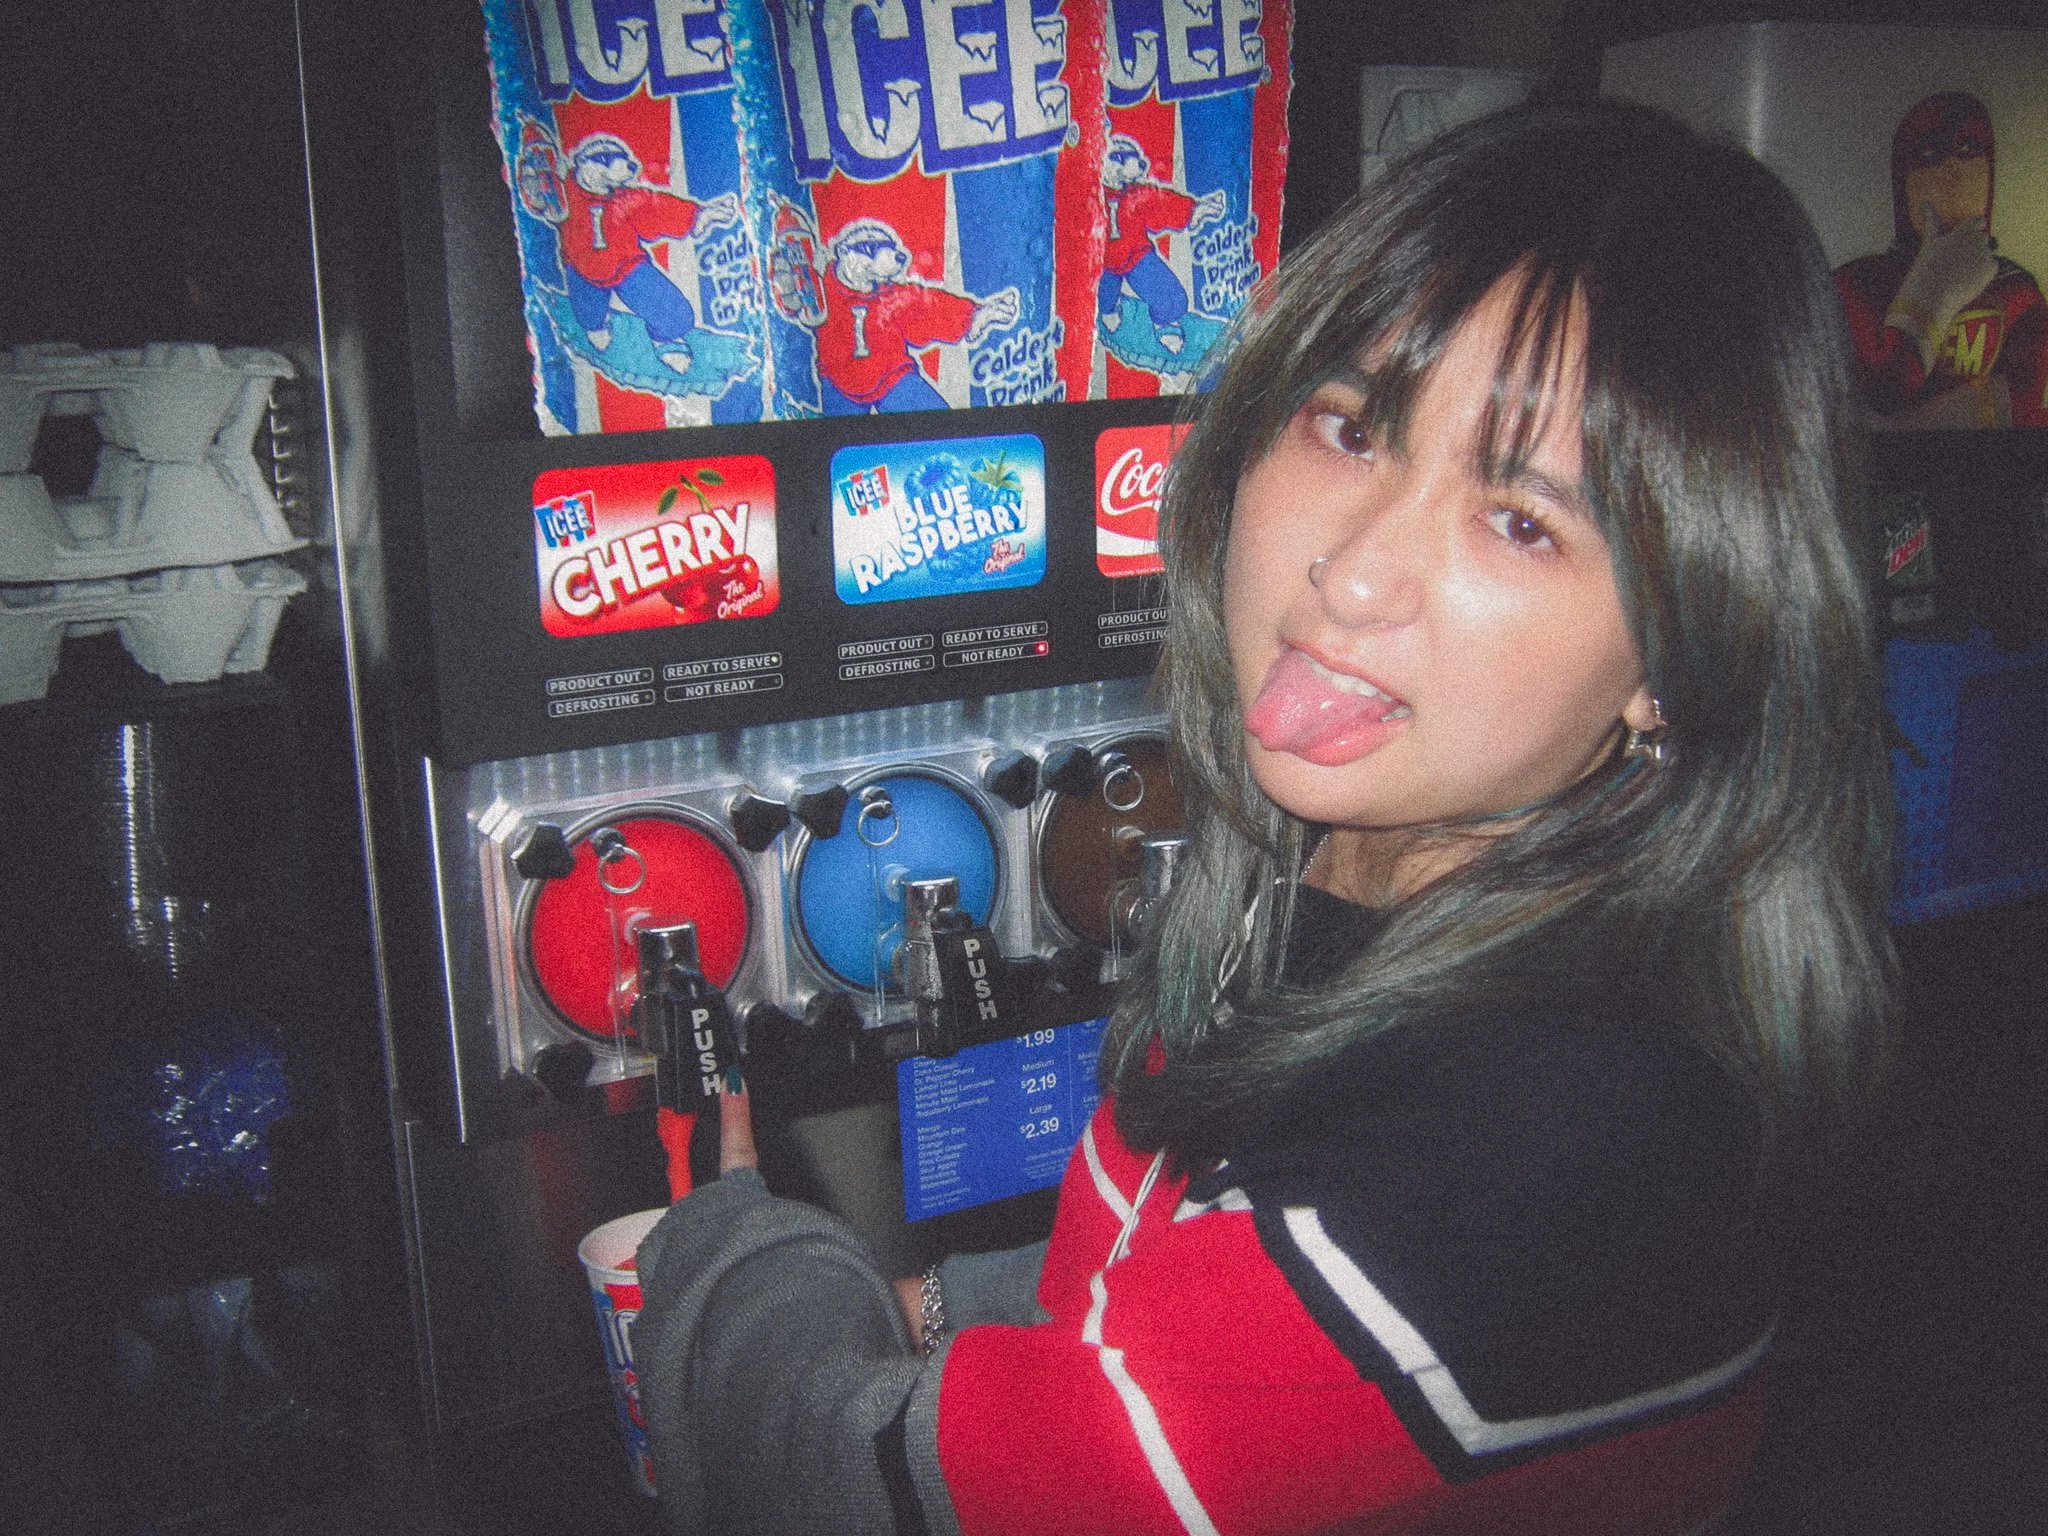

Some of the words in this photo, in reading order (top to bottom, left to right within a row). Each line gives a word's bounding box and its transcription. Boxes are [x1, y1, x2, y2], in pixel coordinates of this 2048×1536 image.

[782, 0, 1068, 160] ICEE
[1193, 218, 1257, 260] Coldest
[700, 230, 753, 271] Cold
[1208, 243, 1251, 284] Drink
[1204, 288, 1221, 306] in
[973, 321, 1062, 380] Coldest
[846, 477, 887, 509] ICEE
[1101, 448, 1166, 516] Coc
[547, 501, 592, 538] ICEE
[894, 485, 973, 533] BLUE
[850, 500, 1028, 594] RASPBERRY
[983, 542, 1025, 574] Original
[991, 537, 1011, 559] The
[553, 503, 749, 617] CHERRY
[717, 581, 764, 619] Original
[722, 579, 746, 600] The
[1101, 612, 1150, 626] PRODUCT
[1152, 609, 1167, 620] OU
[946, 629, 983, 644] READY
[986, 628, 1000, 639] TO
[1003, 624, 1039, 637] SERVE
[841, 641, 897, 657] PRODUCT
[899, 638, 923, 650] OUT
[961, 651, 985, 663] NOT
[988, 647, 1024, 660] READY
[667, 661, 710, 678] READY
[711, 660, 729, 672] TO
[731, 656, 771, 670] SERVE
[845, 659, 921, 677] DEFROSTING
[549, 672, 612, 693] PRODUCT
[614, 671, 642, 685] OUT
[685, 684, 712, 698] NOT
[714, 679, 755, 693] READY
[555, 694, 639, 714] DEFROSTING
[963, 938, 998, 1020] PUSH
[1017, 1028, 1055, 1048] $1.99
[691, 1008, 721, 1096] PUSH
[952, 1067, 975, 1077] Cherry
[1022, 1059, 1055, 1072] Medium
[1021, 1072, 1057, 1094] $2.19
[1029, 1104, 1053, 1115] Large
[1020, 1116, 1059, 1139] $2.39
